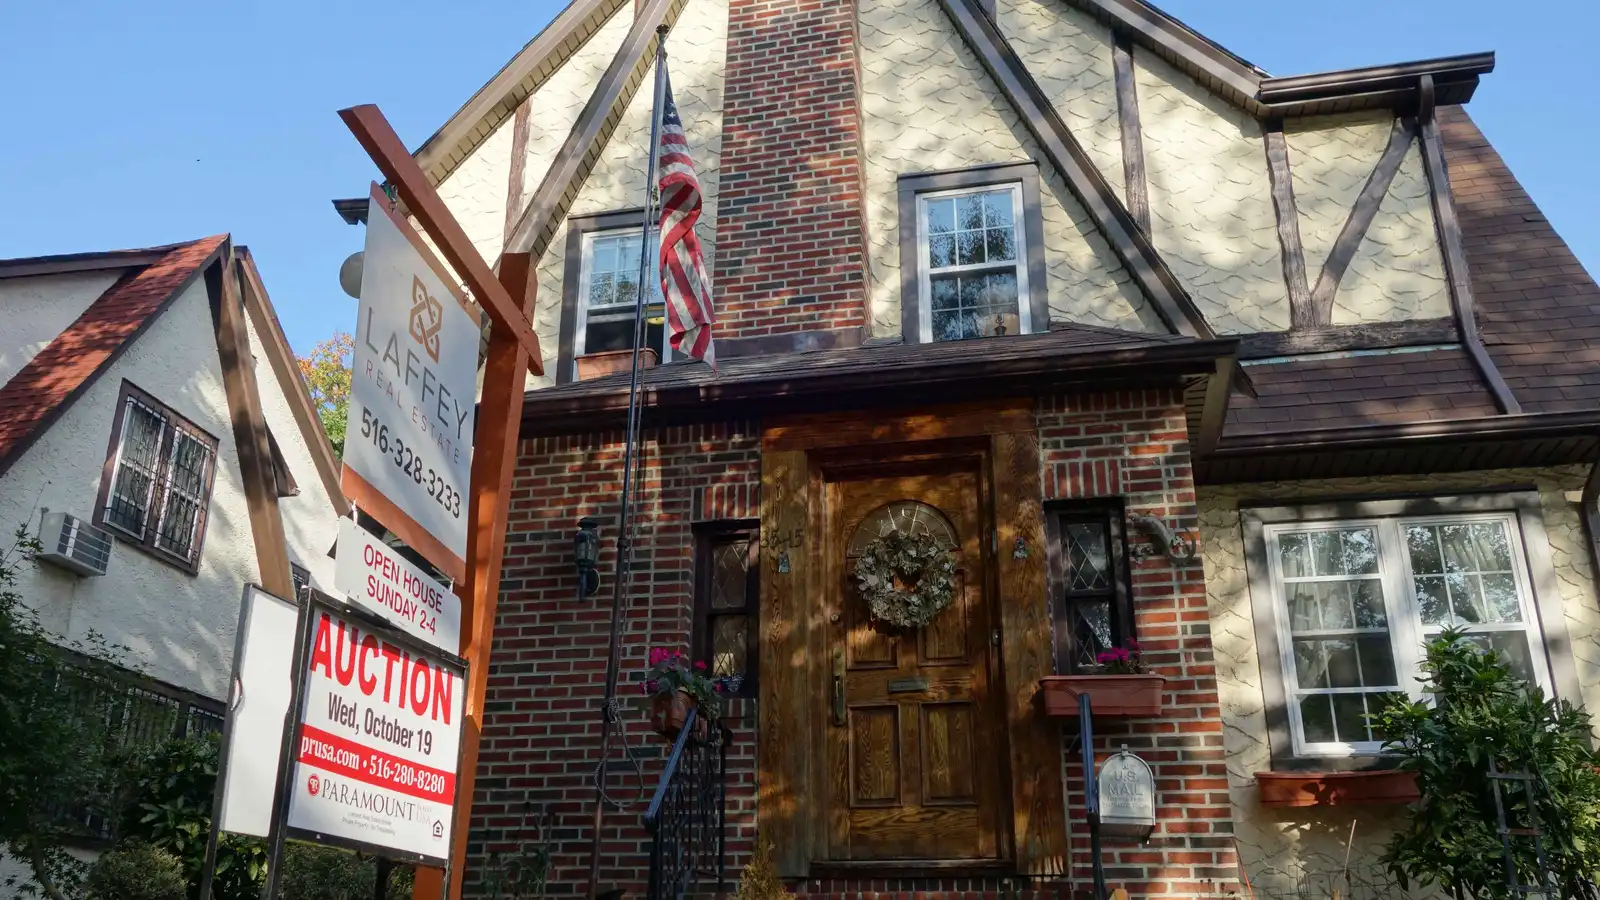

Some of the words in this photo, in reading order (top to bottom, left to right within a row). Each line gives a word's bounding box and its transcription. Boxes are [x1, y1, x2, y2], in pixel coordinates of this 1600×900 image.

[366, 307, 468, 439] LAFFEY
[366, 360, 402, 408] REAL
[412, 406, 459, 464] ESTATE
[361, 406, 460, 518] 516-328-3233
[364, 544, 400, 584] OPEN
[403, 570, 443, 614] HOUSE
[367, 574, 417, 623] SUNDAY
[420, 610, 436, 635] 2-4
[310, 612, 453, 725] AUCTION
[328, 691, 359, 735] Wed,
[364, 707, 414, 748] October
[417, 728, 433, 756] 19
[300, 735, 360, 770] prusa.com
[369, 755, 445, 794] 516-280-8280
[1108, 783, 1143, 796] MAIL
[322, 779, 416, 821] PARAMOUNT
